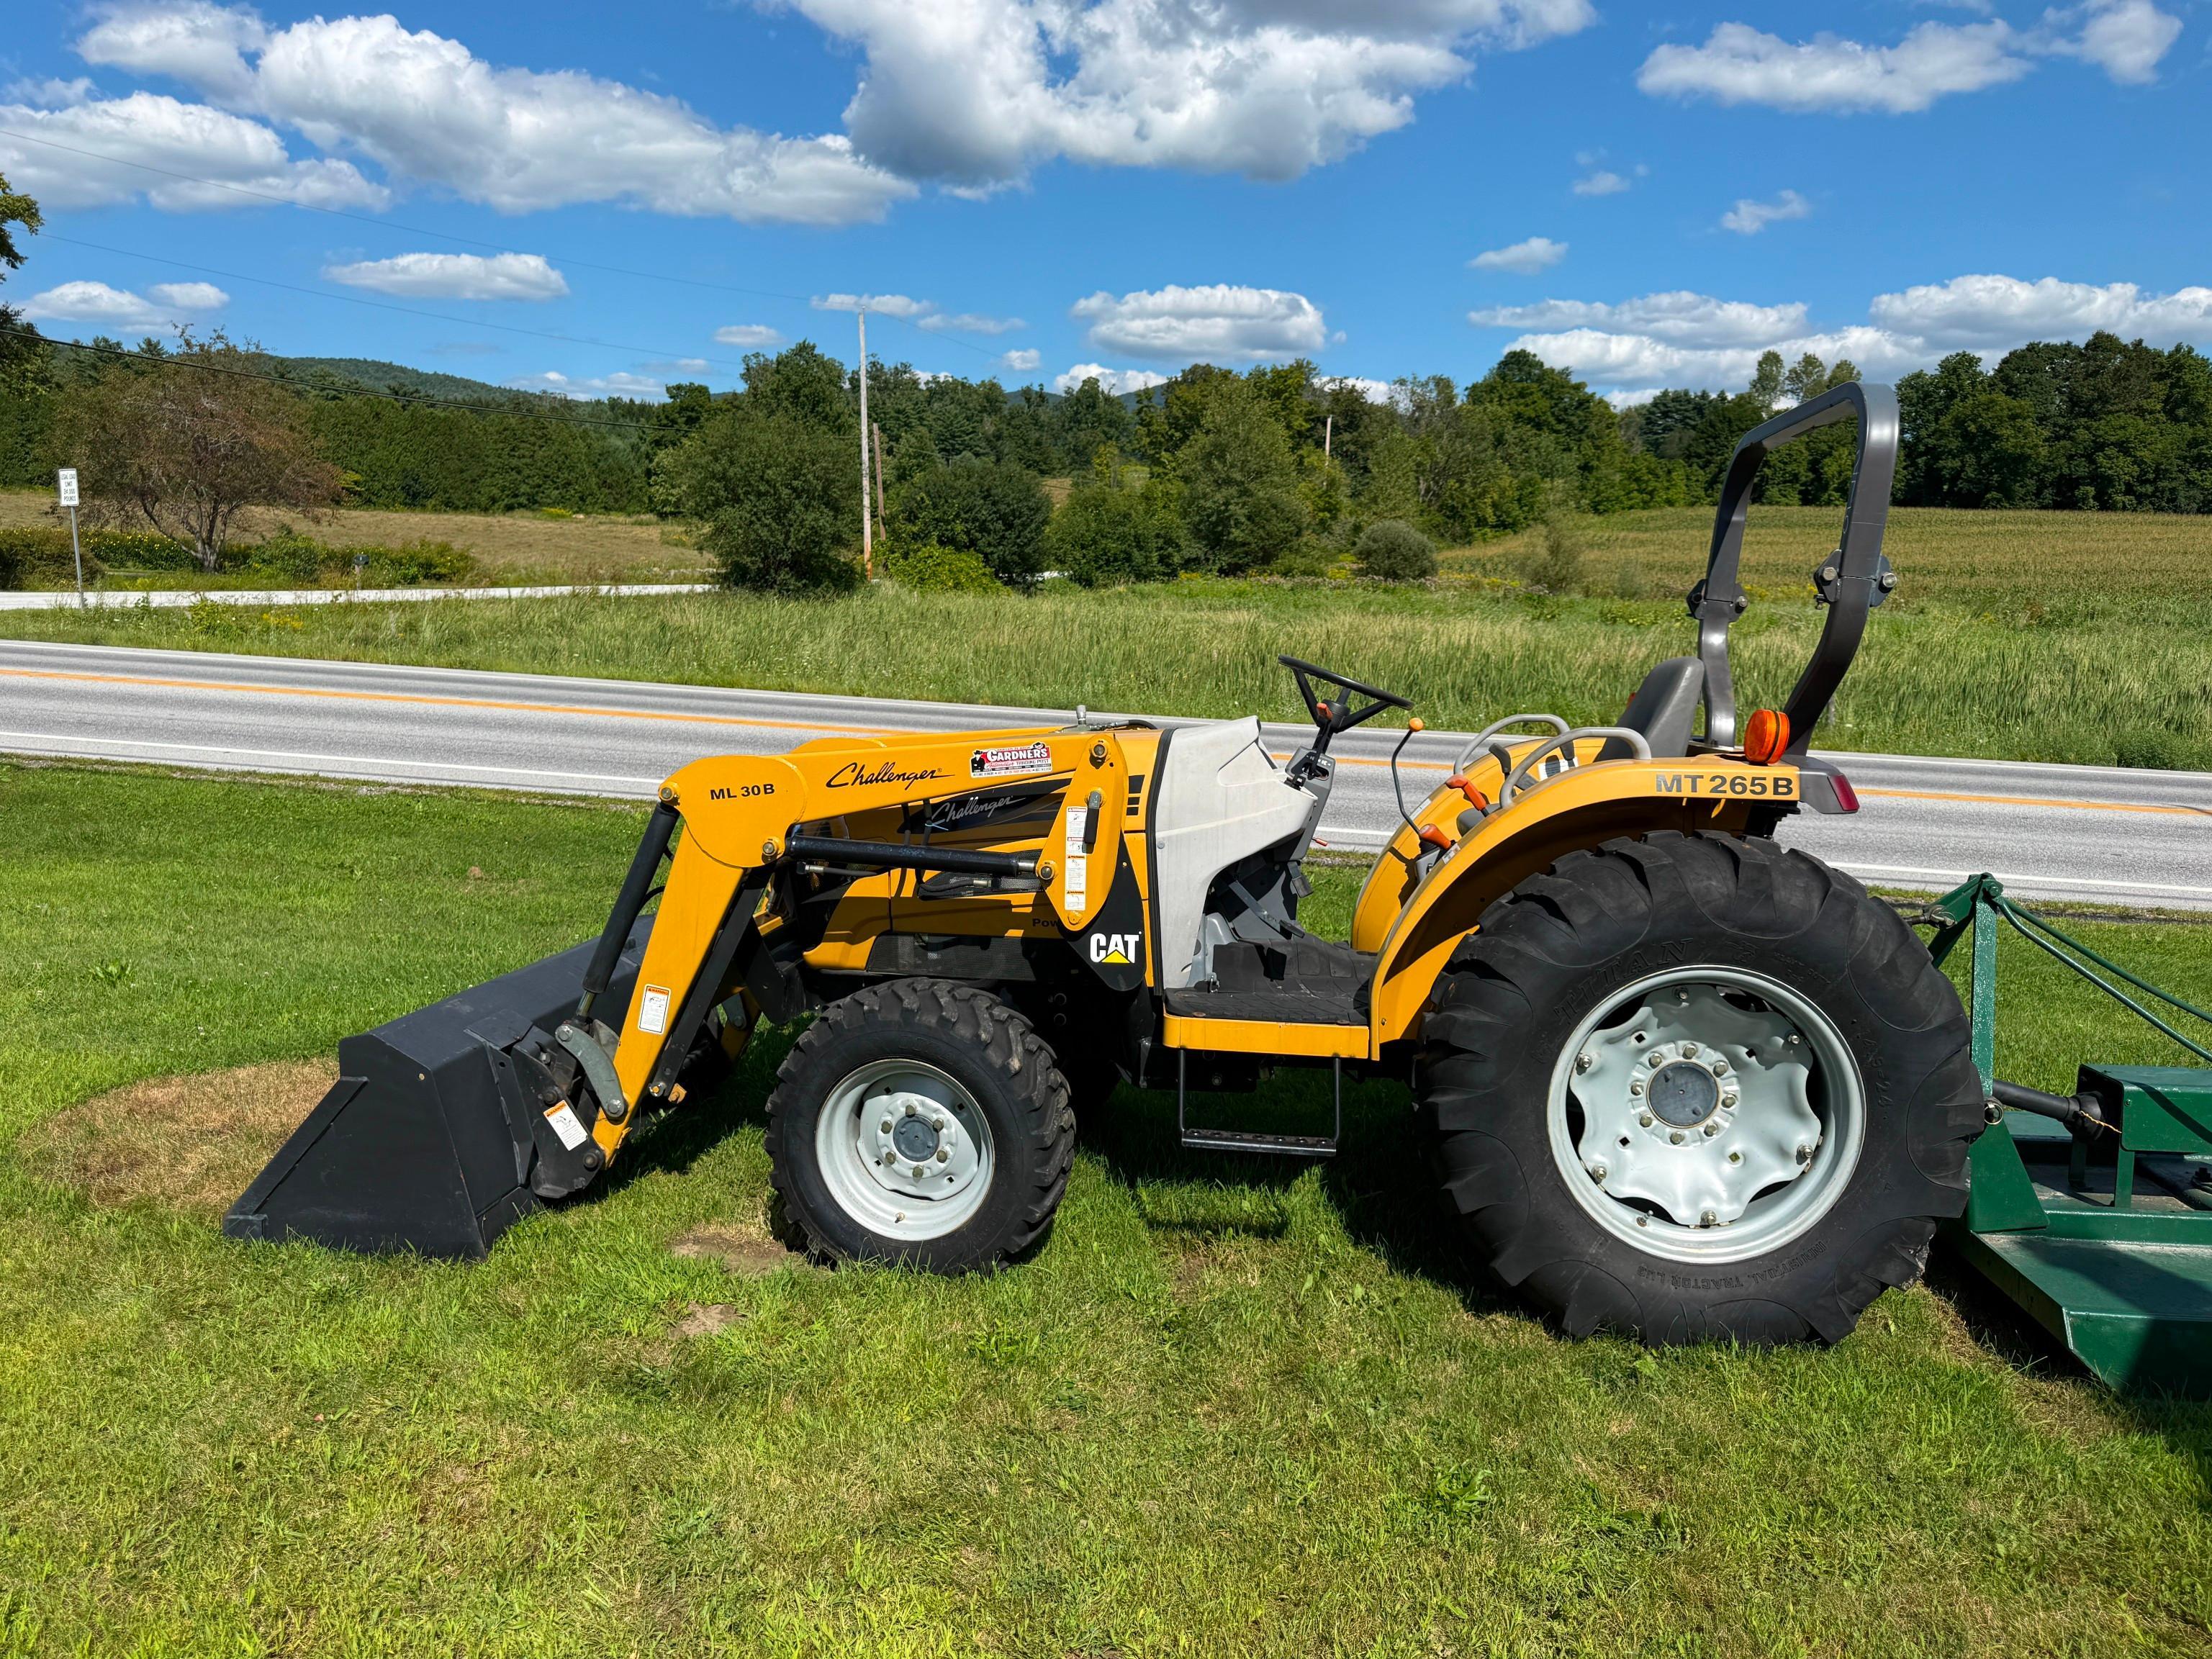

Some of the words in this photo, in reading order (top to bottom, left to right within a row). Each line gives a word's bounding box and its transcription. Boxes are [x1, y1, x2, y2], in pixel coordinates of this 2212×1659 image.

[987, 749, 1048, 762] GARDNERS
[826, 761, 955, 791] Challenger
[931, 796, 1026, 822] Challenger
[1090, 933, 1139, 964] CAT
[1553, 938, 1694, 1025] TITAN
[1637, 1265, 1666, 1283] LUG
[1753, 1241, 1827, 1284] INDUSTRIAL
[1671, 1275, 1744, 1289] TRACTOR
